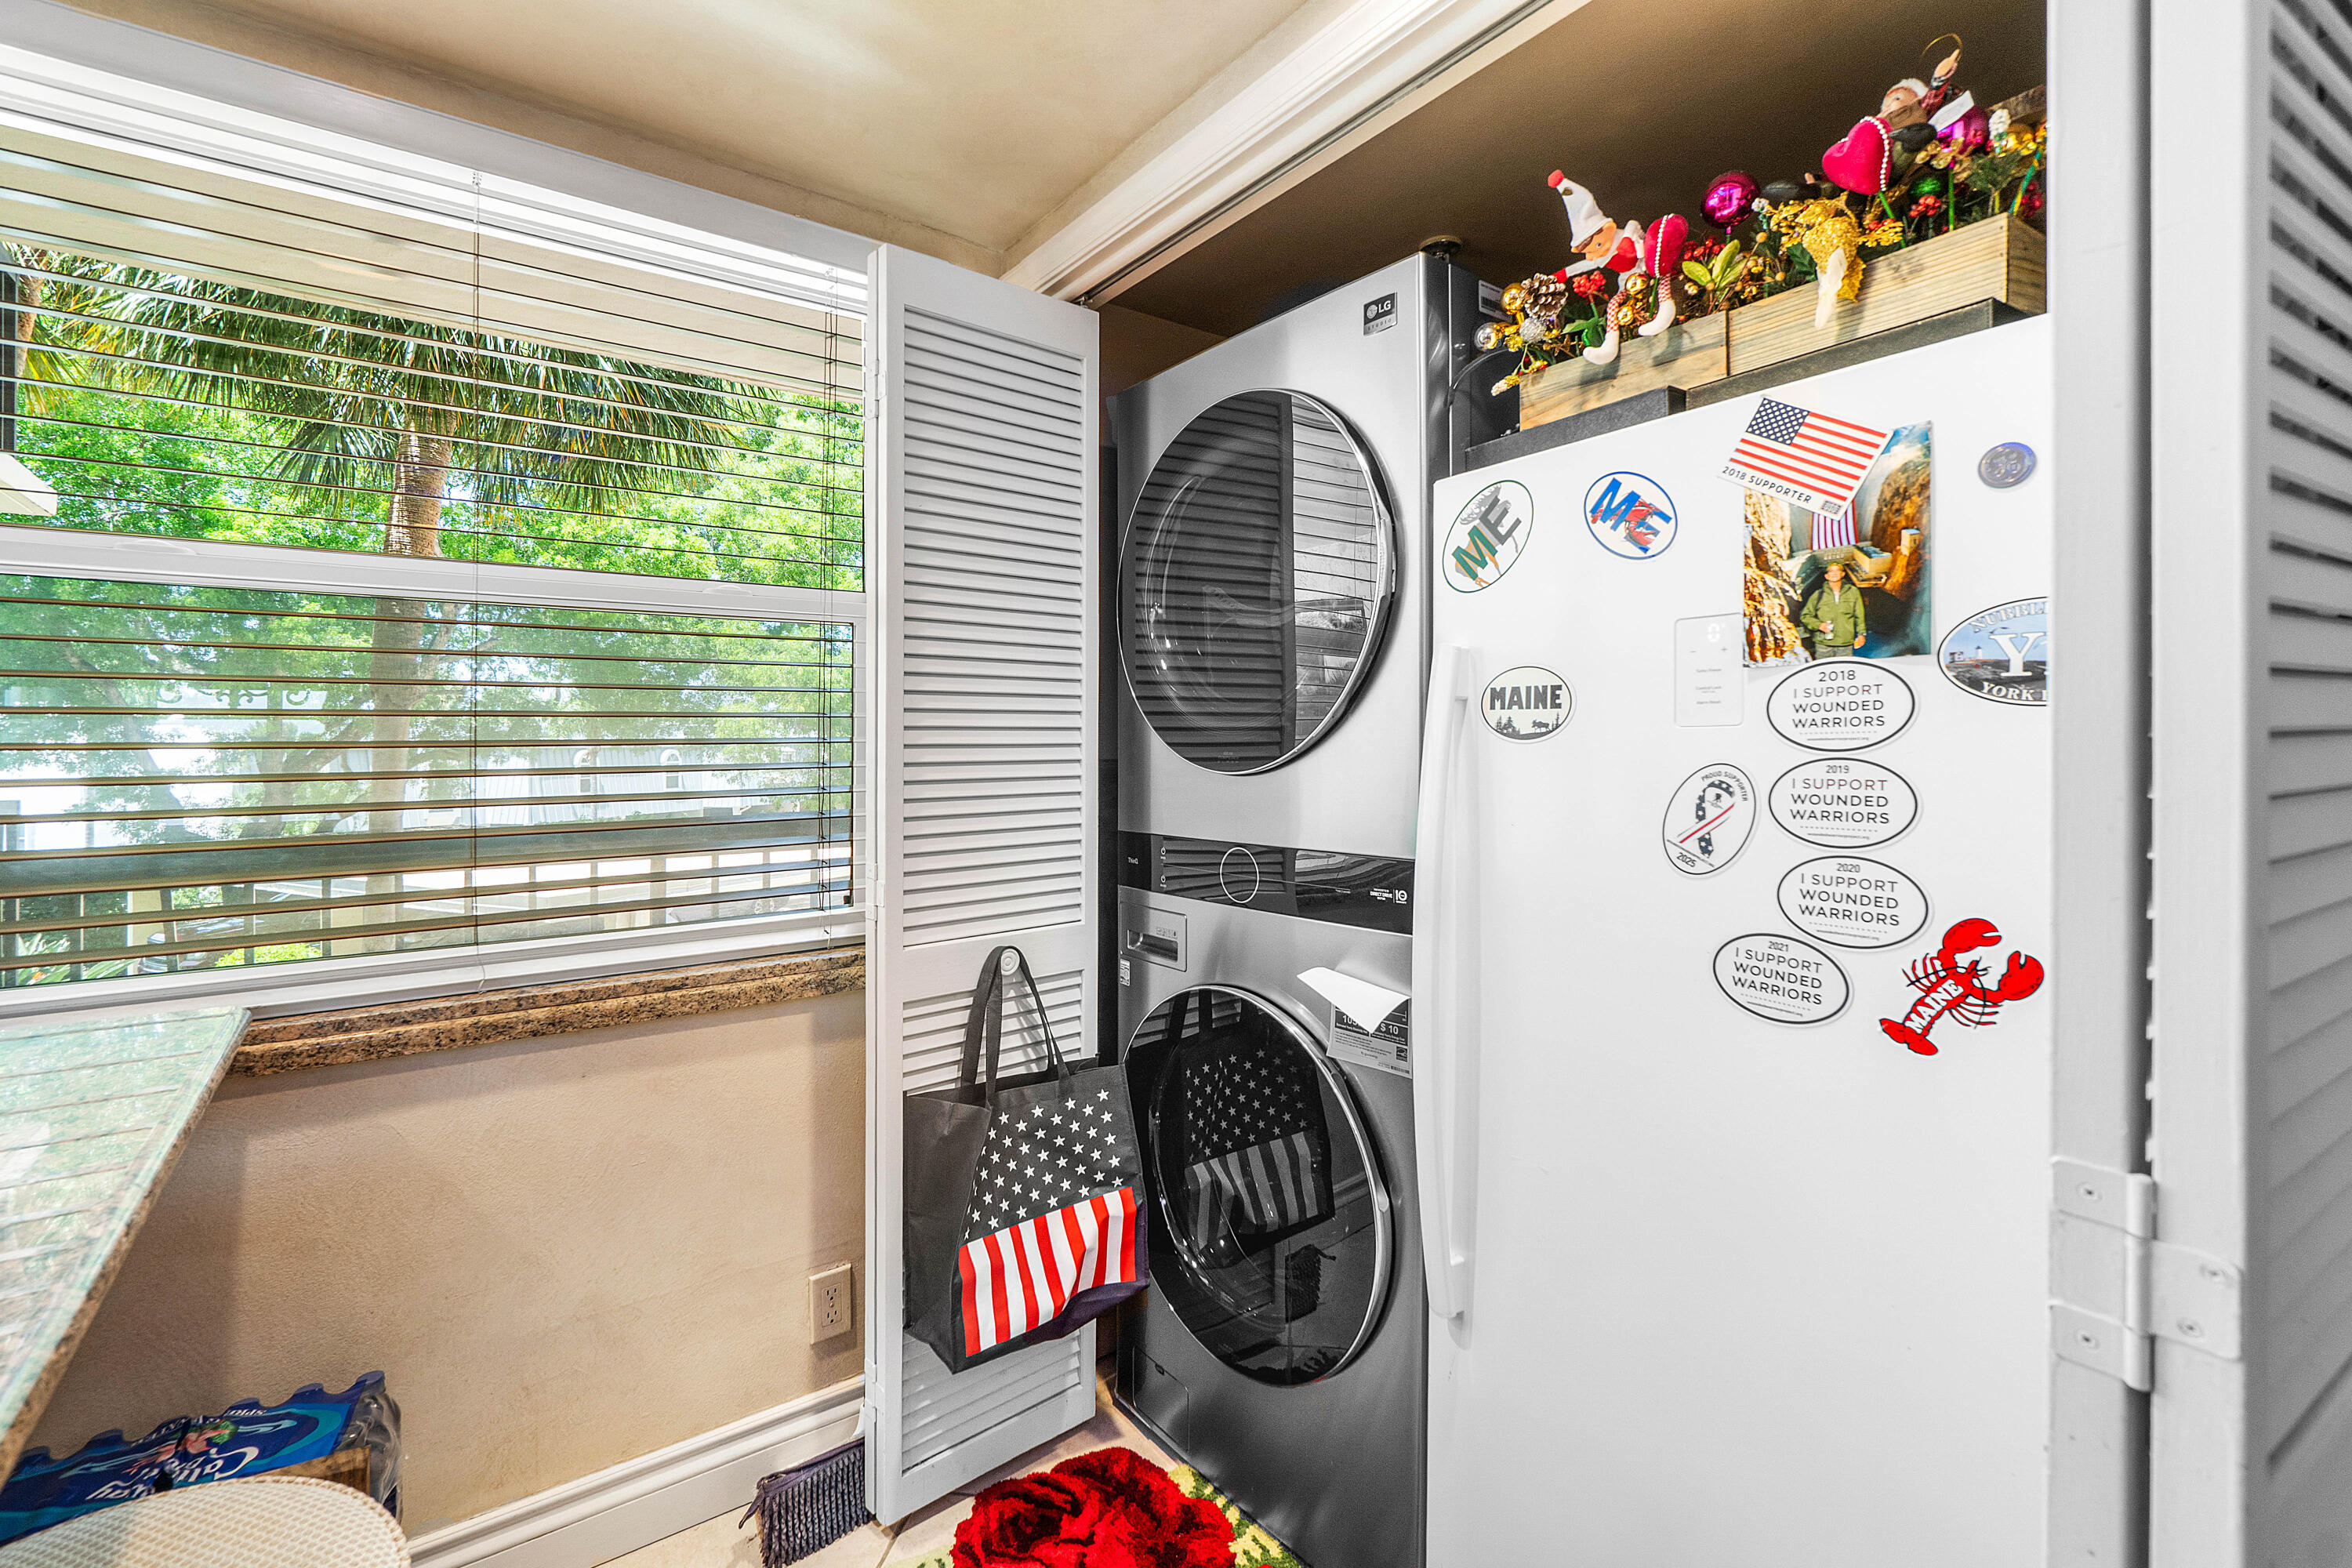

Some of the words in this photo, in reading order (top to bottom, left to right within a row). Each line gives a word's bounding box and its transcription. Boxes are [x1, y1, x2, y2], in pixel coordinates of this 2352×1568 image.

[1378, 300, 1392, 313] LG
[1722, 466, 1747, 481] 2018
[1748, 475, 1812, 503] SUPPORTER
[1589, 477, 1672, 554] ME
[1452, 495, 1522, 581] ME
[1989, 631, 2049, 677] Y
[1819, 670, 1856, 682] 2018
[1490, 684, 1563, 710] MAINE
[1793, 688, 1798, 699] I
[1803, 684, 1883, 698] SUPPORT
[1981, 681, 2035, 700] YORK
[1793, 699, 1884, 713] WOUNDED
[1792, 716, 1886, 728] WARRIORS
[1825, 765, 1849, 774] 2019
[1791, 778, 1796, 789] I
[1802, 778, 1888, 791] SUPPORT
[1791, 793, 1889, 808] WOUNDED
[1790, 808, 1889, 824] WARRIORS
[1676, 851, 1697, 868] 2025
[1836, 862, 1861, 873] 2020
[1801, 873, 1805, 884] I
[1811, 874, 1898, 892] SUPPORT
[1799, 888, 1899, 909] WOUNDED
[1798, 904, 1900, 926] WARRIORS
[1768, 941, 1788, 953] 2021
[1744, 949, 1823, 974] SUPPORT
[1733, 961, 1823, 989] WOUNDED
[1732, 975, 1822, 1005] WARRIORS
[1904, 978, 1964, 1034] MAINE
[1388, 1025, 1399, 1035] 10
[85, 1446, 260, 1501] Callway
